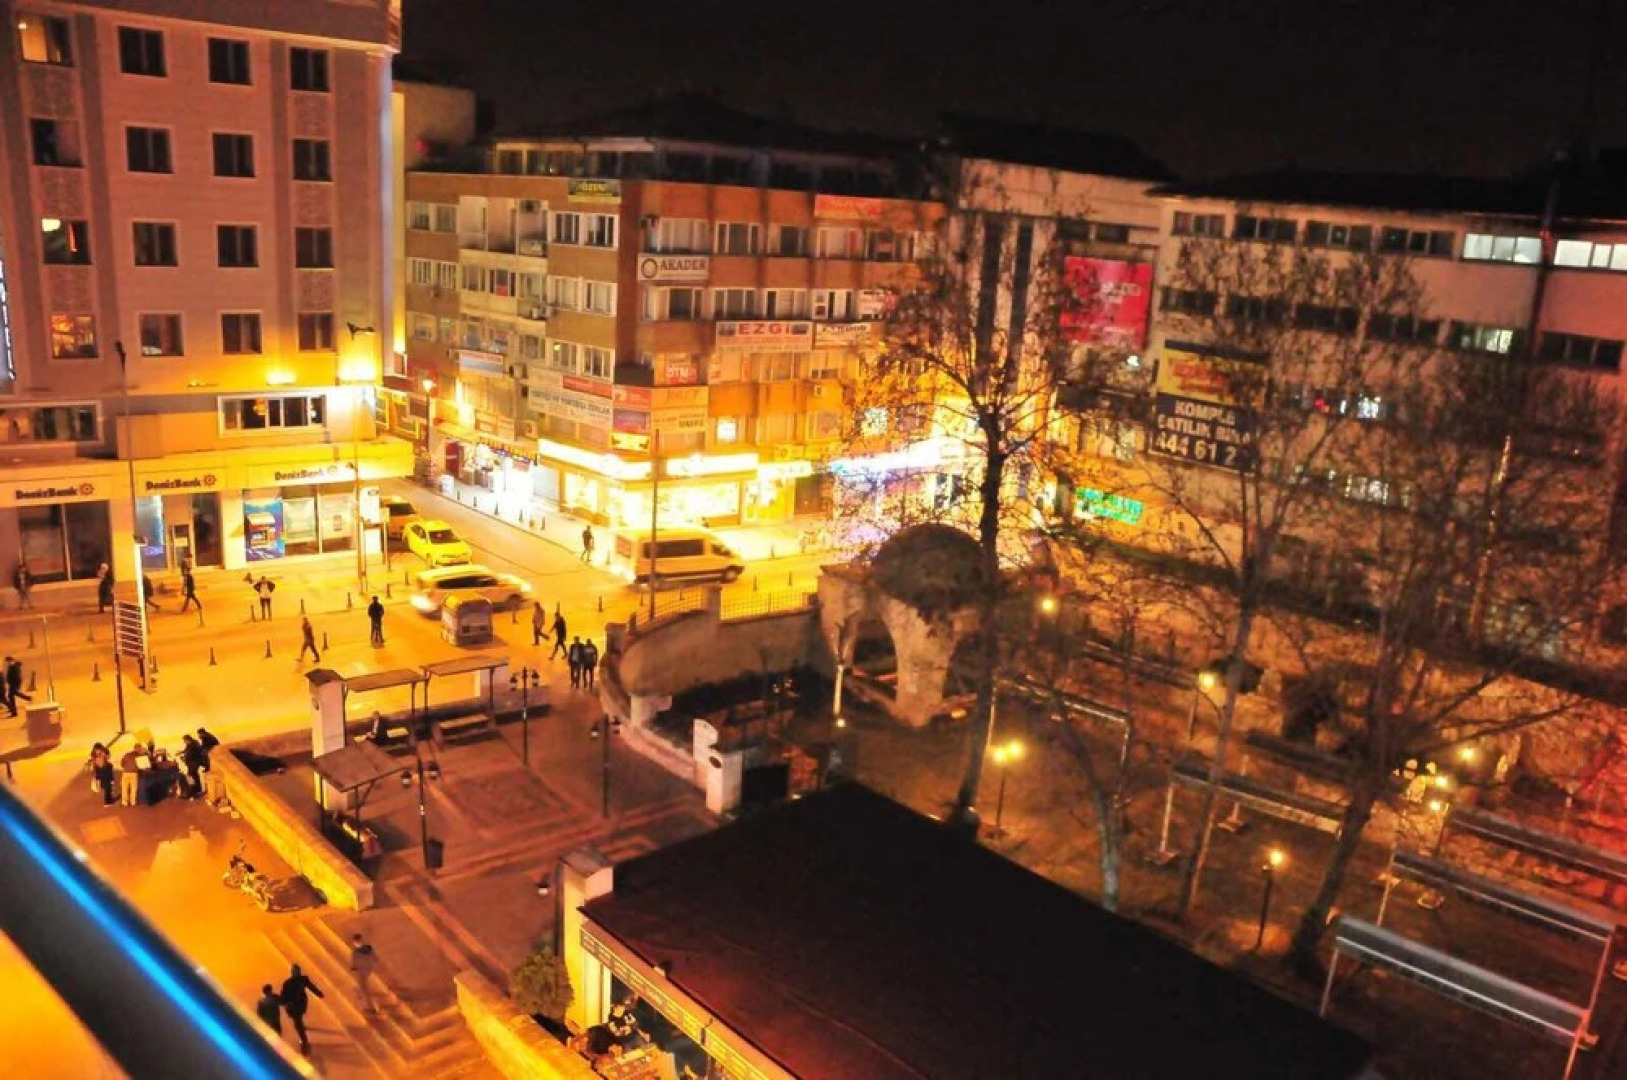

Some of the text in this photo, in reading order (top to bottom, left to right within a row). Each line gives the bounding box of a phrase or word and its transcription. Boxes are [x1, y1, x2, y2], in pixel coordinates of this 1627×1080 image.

[275, 466, 327, 481] DenizBank
[145, 476, 202, 491] DenizBank
[15, 485, 78, 500] DenizBank
